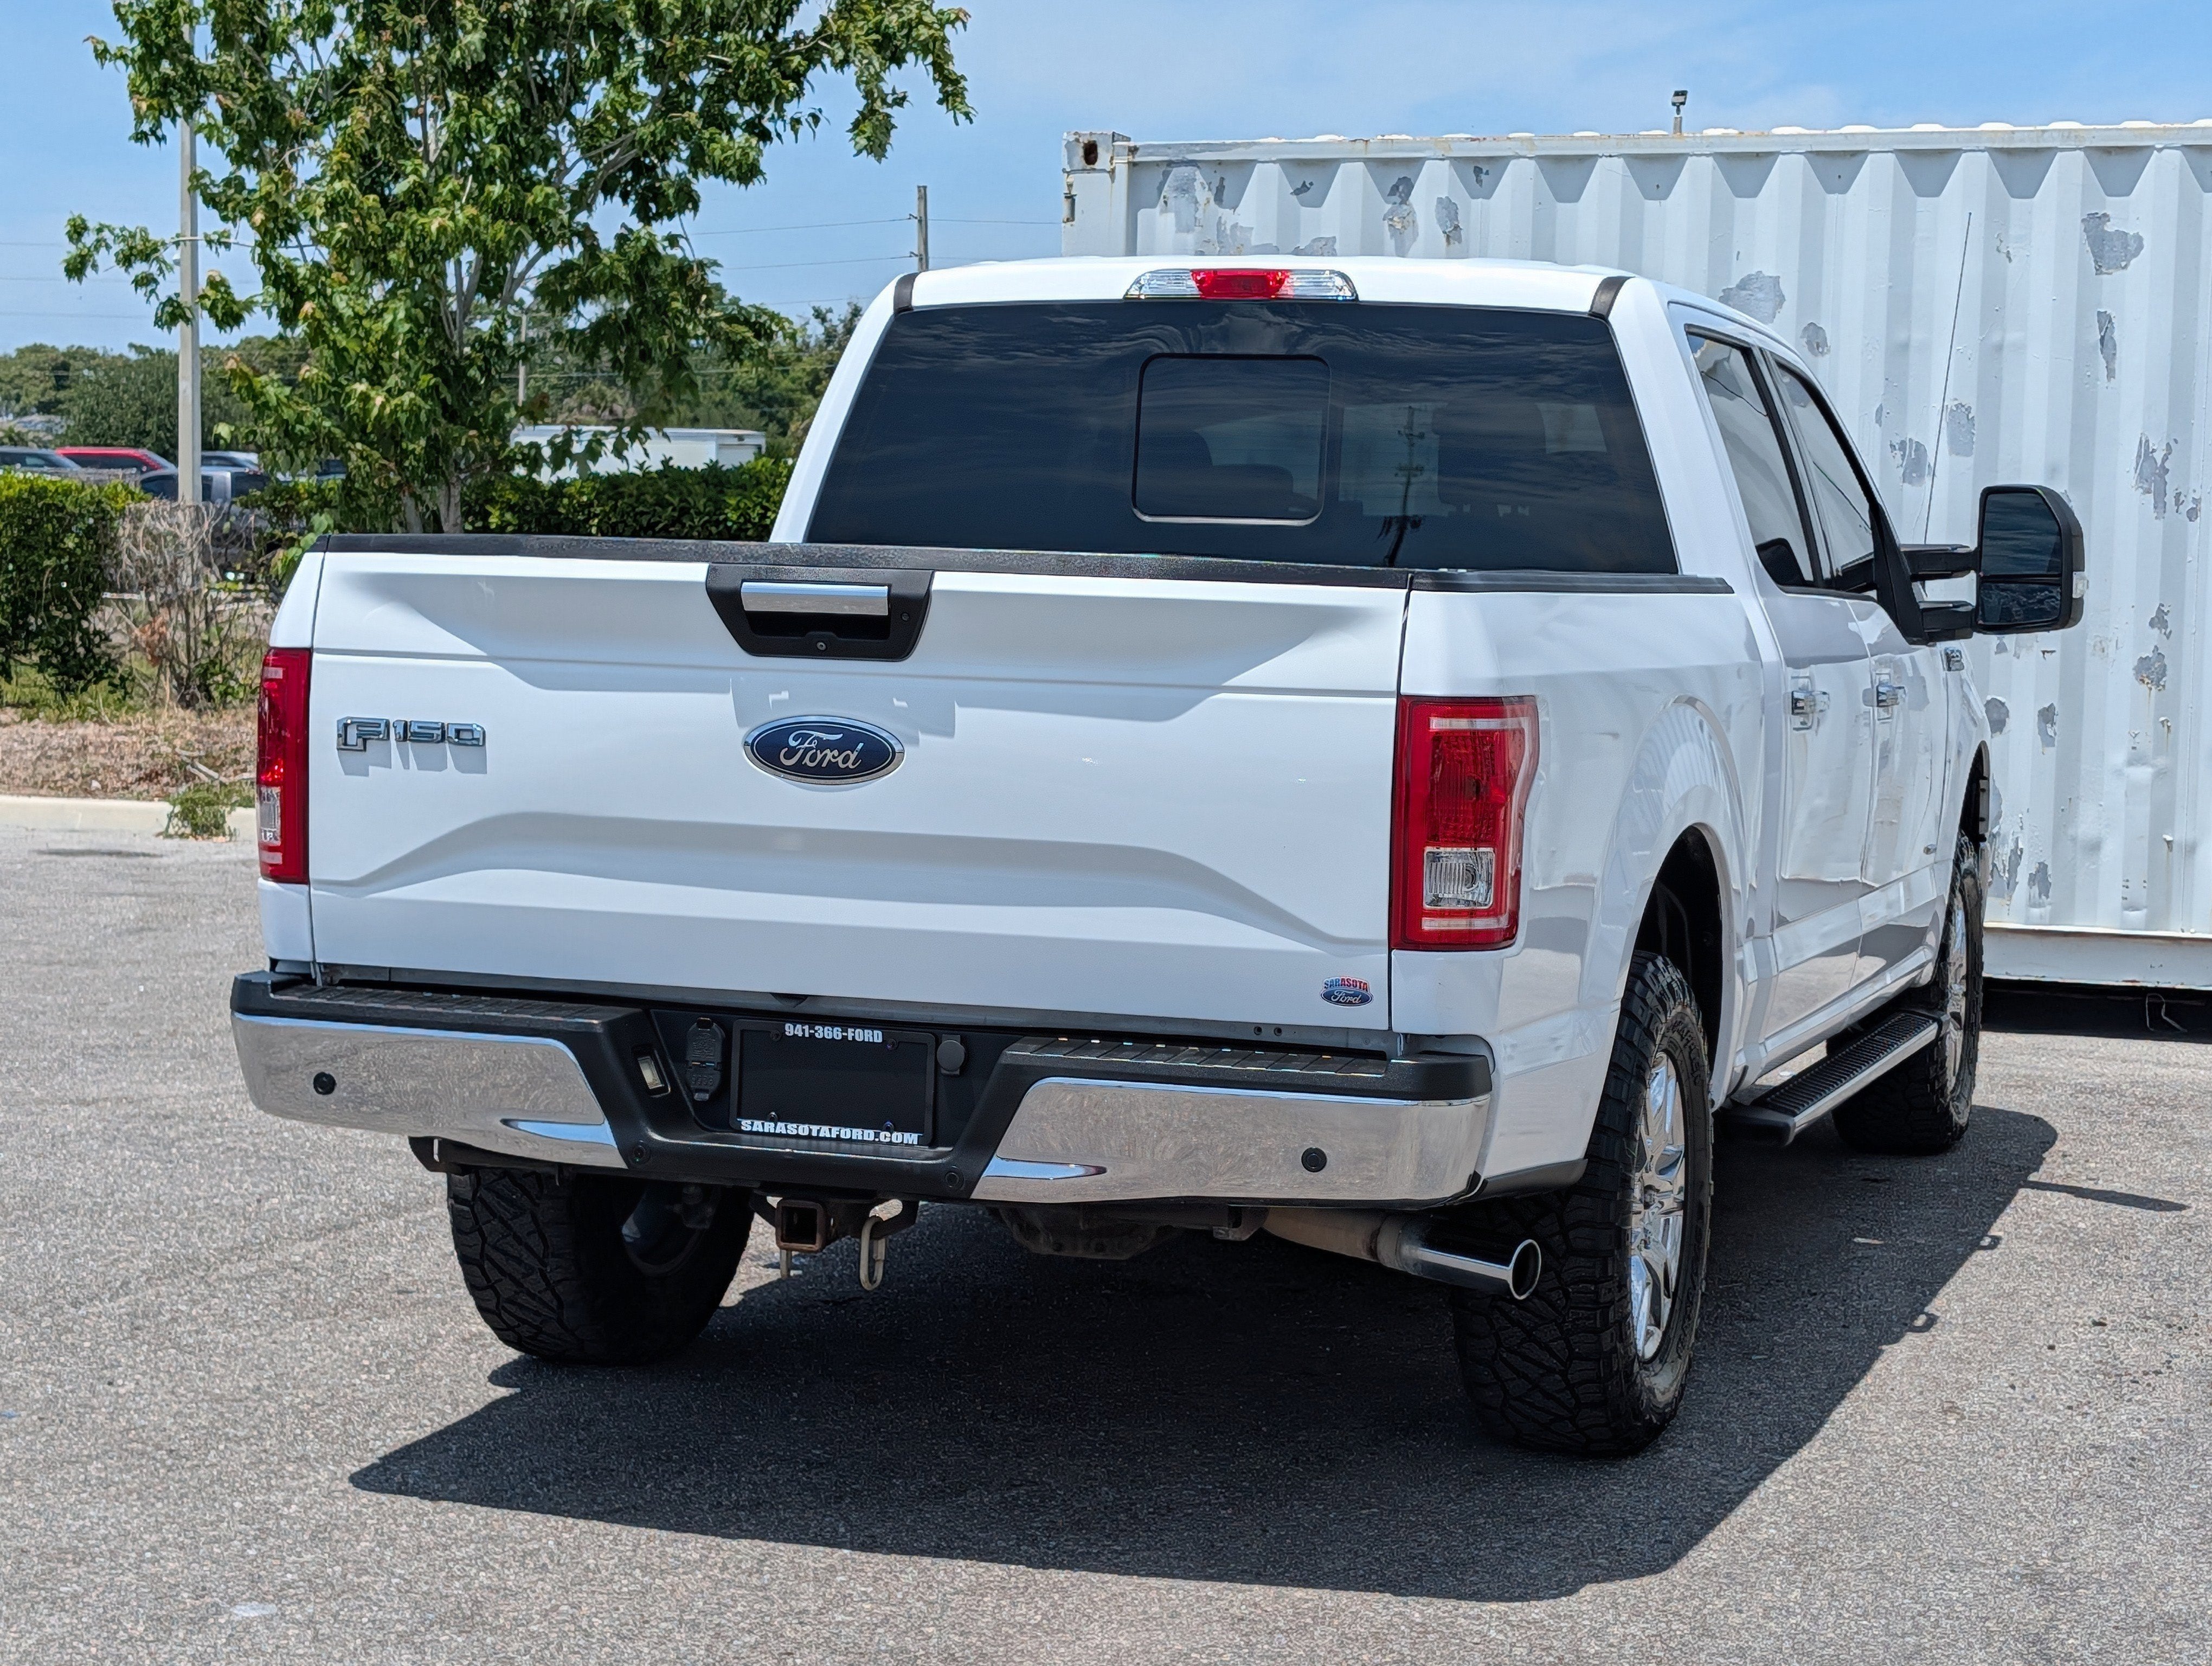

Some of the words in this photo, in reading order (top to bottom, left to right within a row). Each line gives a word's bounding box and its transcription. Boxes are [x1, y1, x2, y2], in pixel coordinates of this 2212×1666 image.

[780, 730, 864, 769] Ford
[1324, 978, 1368, 992] SARASOTA
[1330, 989, 1361, 1003] Ford
[785, 1023, 883, 1043] 941-366-FORD
[741, 1120, 918, 1145] SARASOTAFORD.COM
